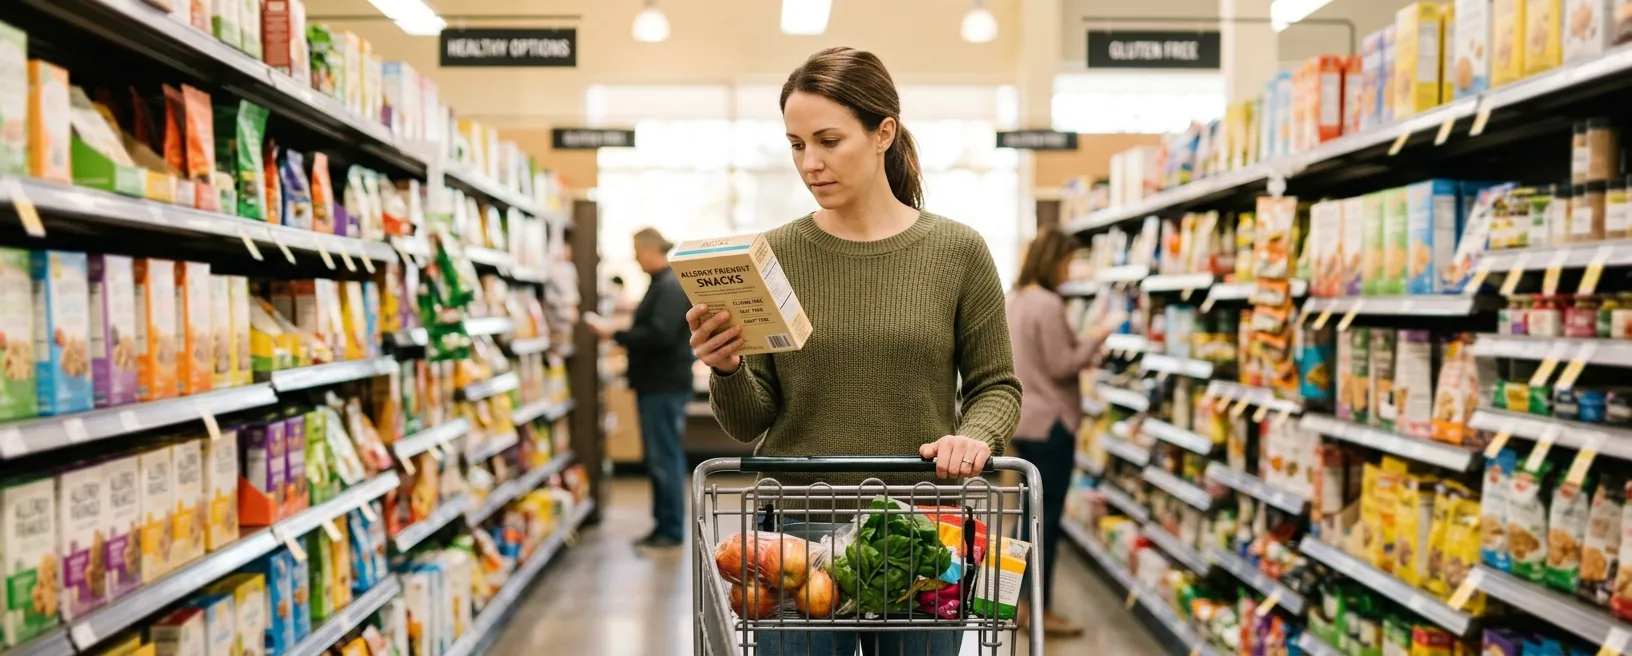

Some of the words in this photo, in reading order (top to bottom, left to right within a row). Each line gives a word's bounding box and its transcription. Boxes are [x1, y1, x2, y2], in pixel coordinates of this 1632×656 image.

[447, 38, 508, 57] HEALTHY
[509, 38, 570, 57] OPTIONS
[1108, 40, 1162, 60] GLUTEN
[1163, 40, 1199, 60] FREE
[696, 274, 744, 288] SNACKS
